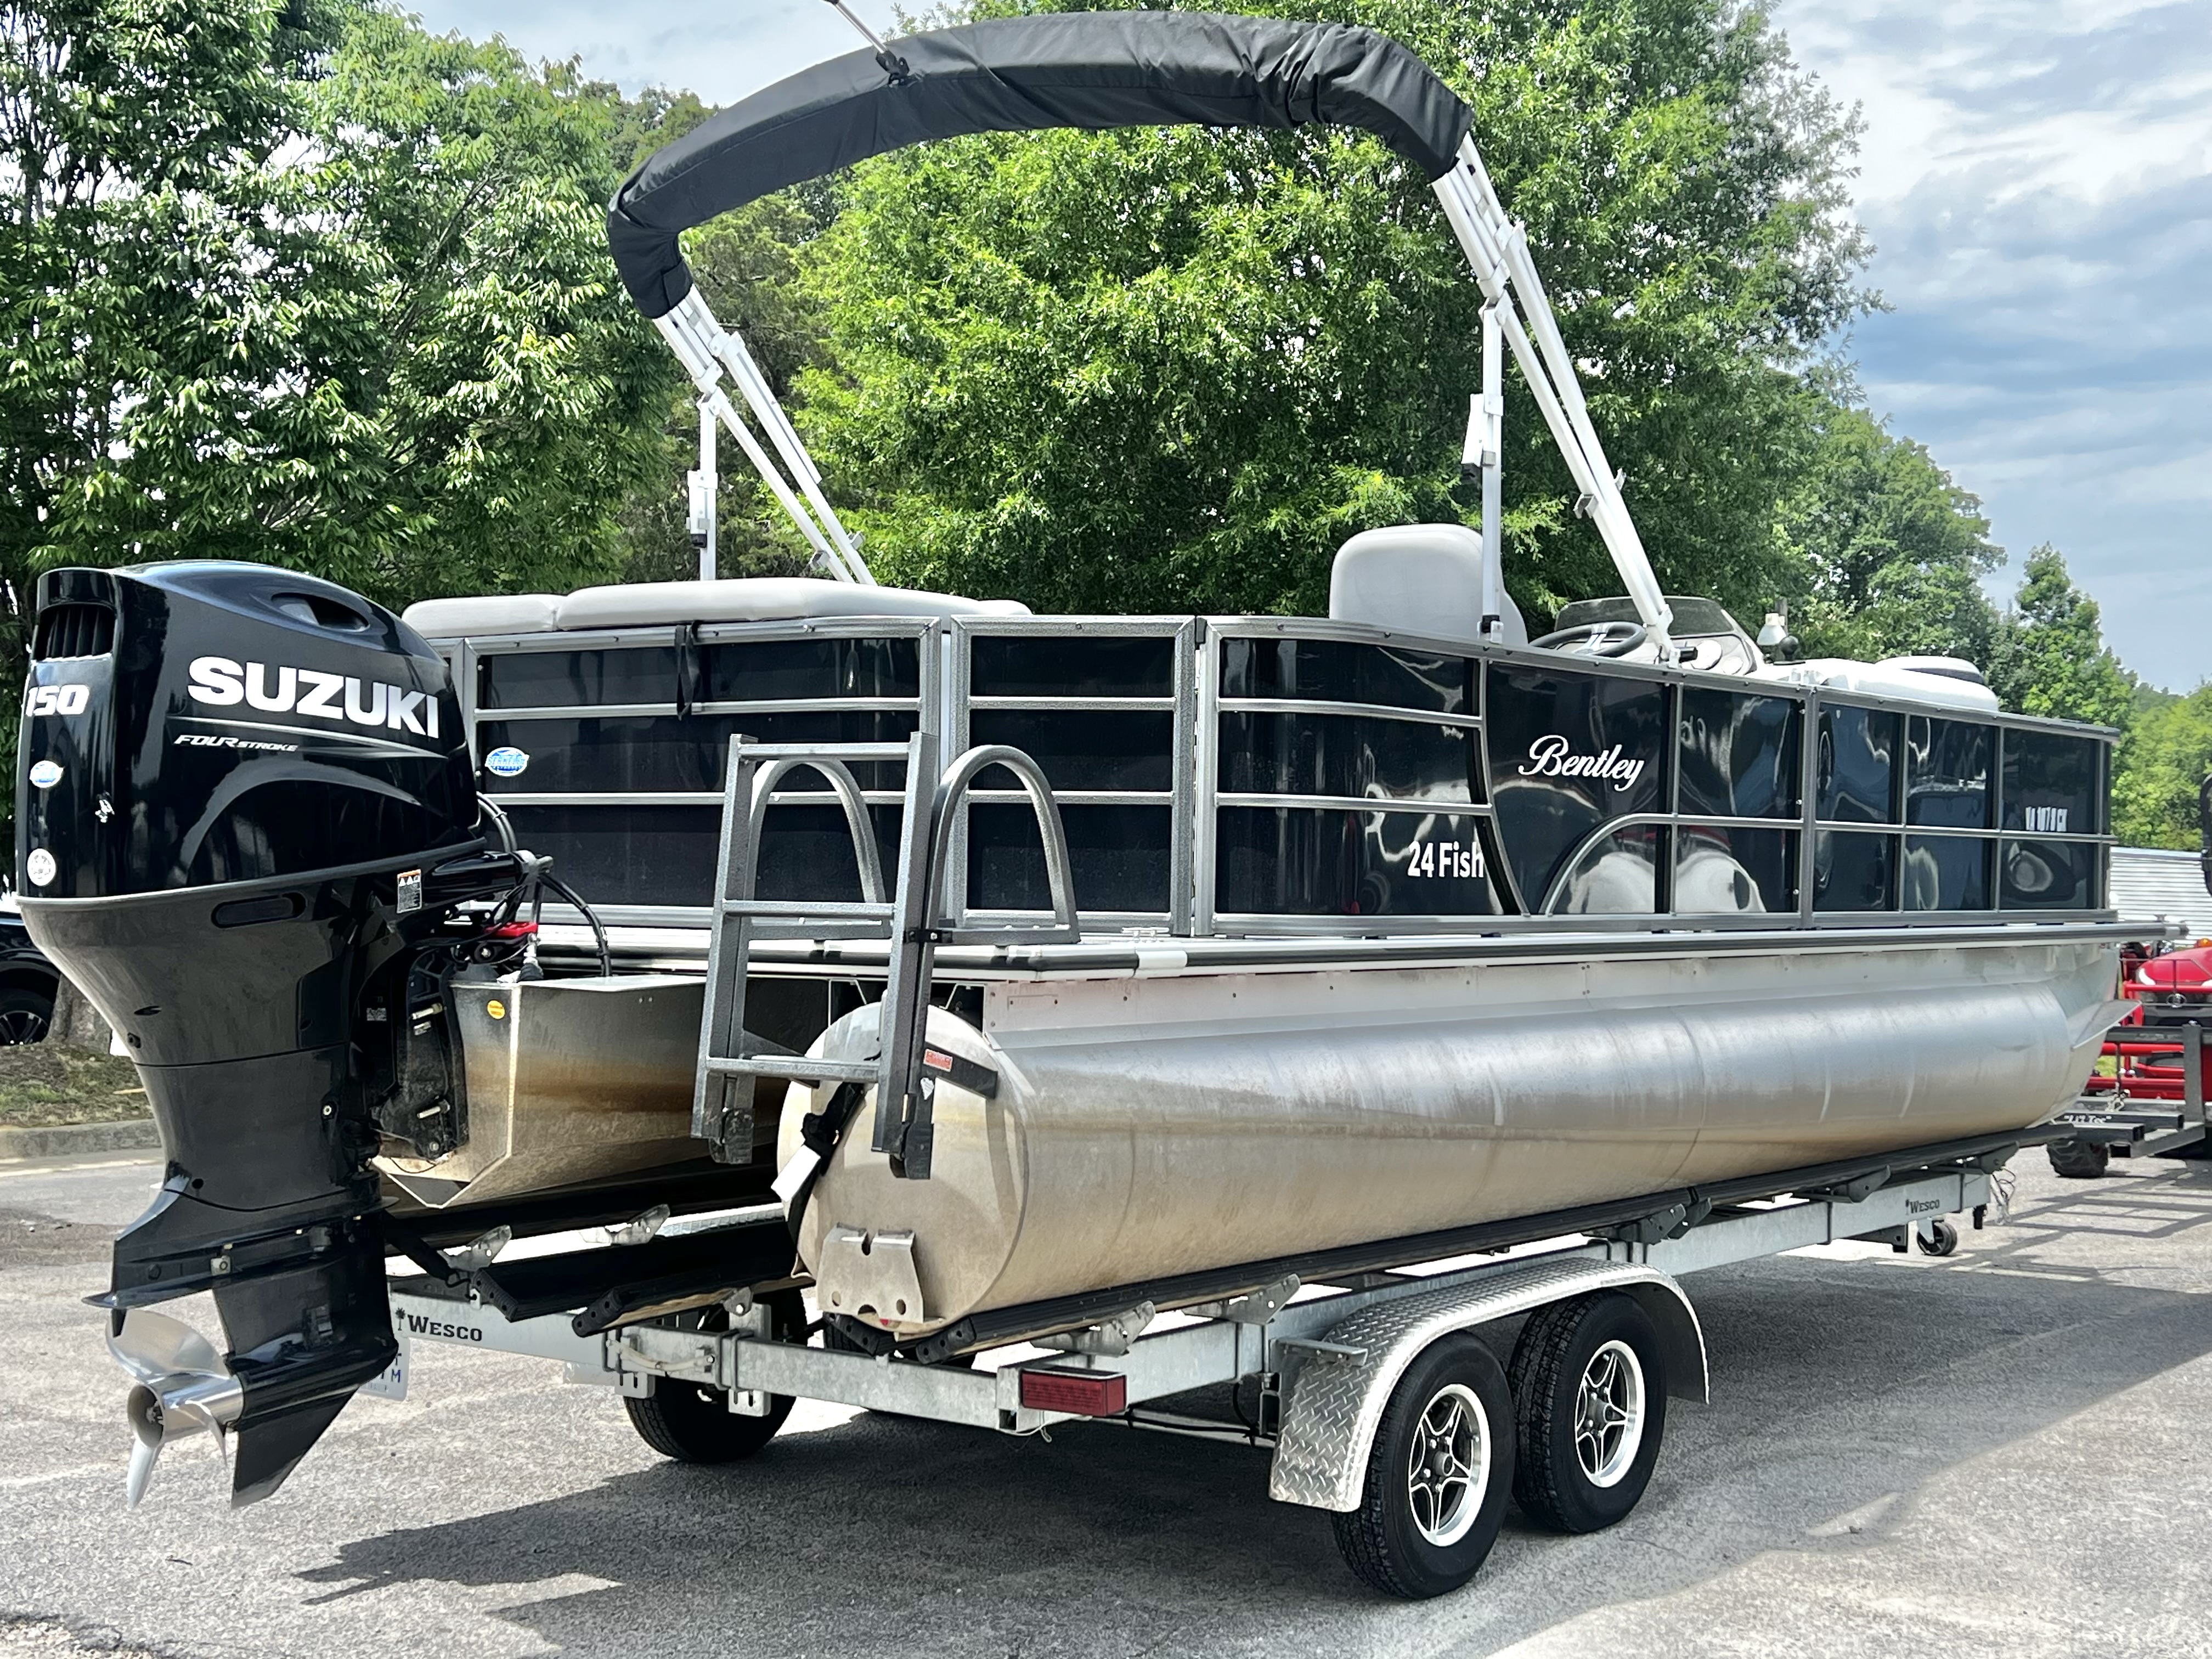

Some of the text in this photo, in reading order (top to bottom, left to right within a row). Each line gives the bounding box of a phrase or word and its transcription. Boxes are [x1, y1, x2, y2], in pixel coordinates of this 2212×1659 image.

[26, 685, 89, 716] 150
[188, 656, 438, 738] SUZUKI
[174, 735, 239, 747] FOUR
[1518, 735, 1644, 791] Bentley
[1408, 840, 1483, 877] 24 Fish
